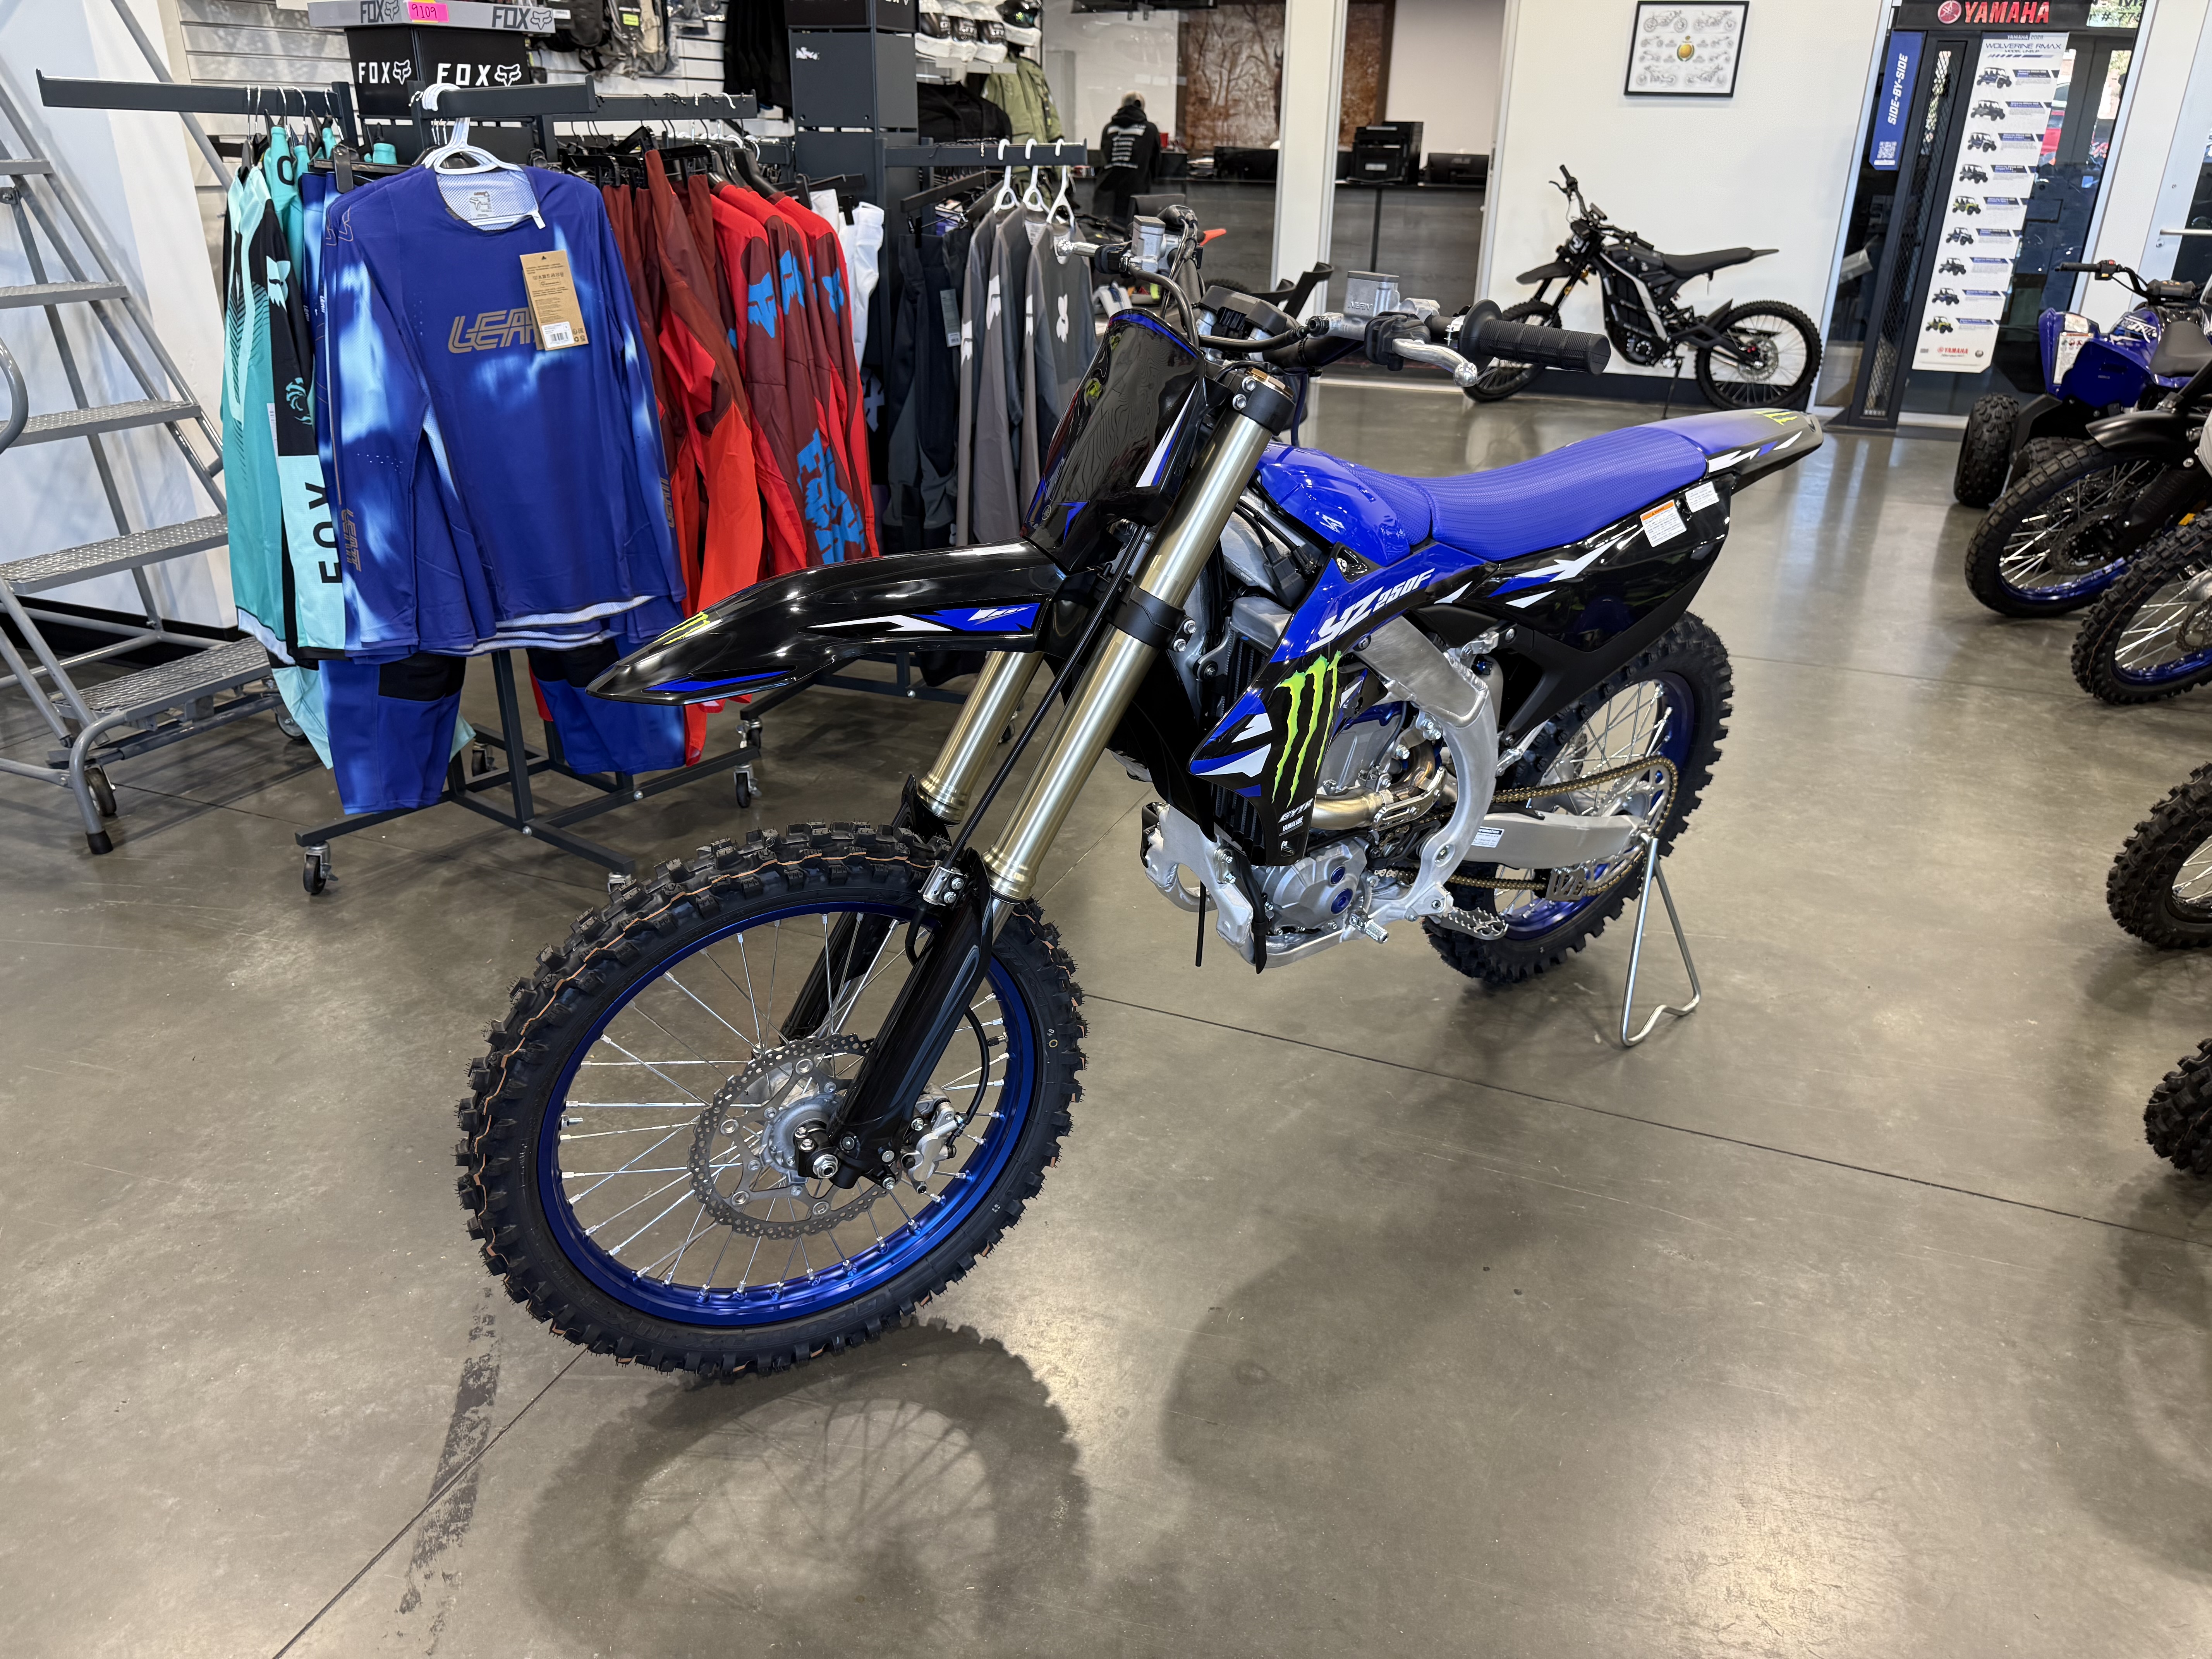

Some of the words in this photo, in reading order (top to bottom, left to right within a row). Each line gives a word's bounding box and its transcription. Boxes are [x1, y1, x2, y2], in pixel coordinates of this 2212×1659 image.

[361, 1, 384, 23] FOX
[412, 4, 437, 19] 9109
[492, 6, 531, 29] FOX
[1965, 1, 2049, 23] YAMAHA
[359, 62, 390, 84] FOX
[437, 63, 491, 86] FOX
[1887, 53, 1908, 125] SIDE-BY-SIDE
[448, 307, 533, 354] LEA
[342, 508, 361, 572] LEATT
[1278, 798, 1314, 823] GYTR
[1283, 816, 1304, 832] YAMALUBE
